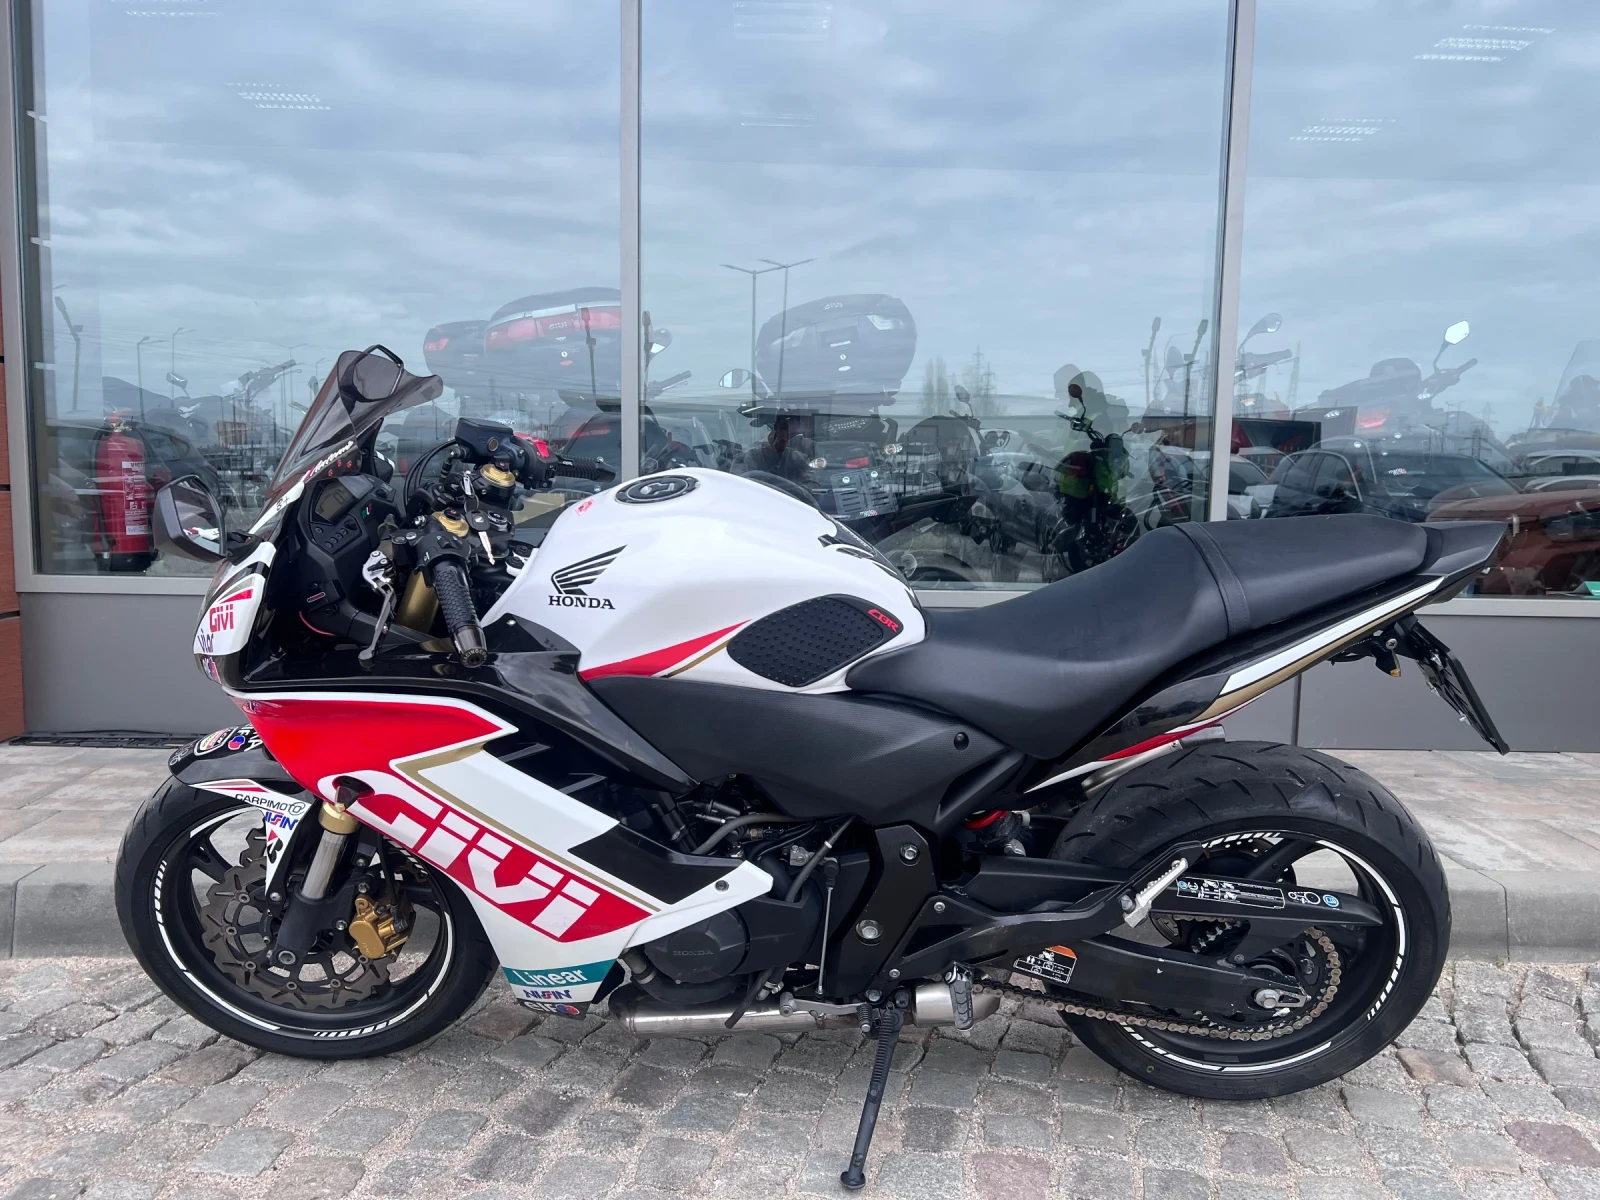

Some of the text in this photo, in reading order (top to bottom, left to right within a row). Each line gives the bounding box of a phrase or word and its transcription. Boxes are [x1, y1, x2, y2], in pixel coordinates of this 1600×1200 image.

[548, 595, 616, 610] HONDA
[209, 603, 235, 632] GIVI
[868, 609, 899, 632] CBR
[512, 969, 588, 986] Linear
